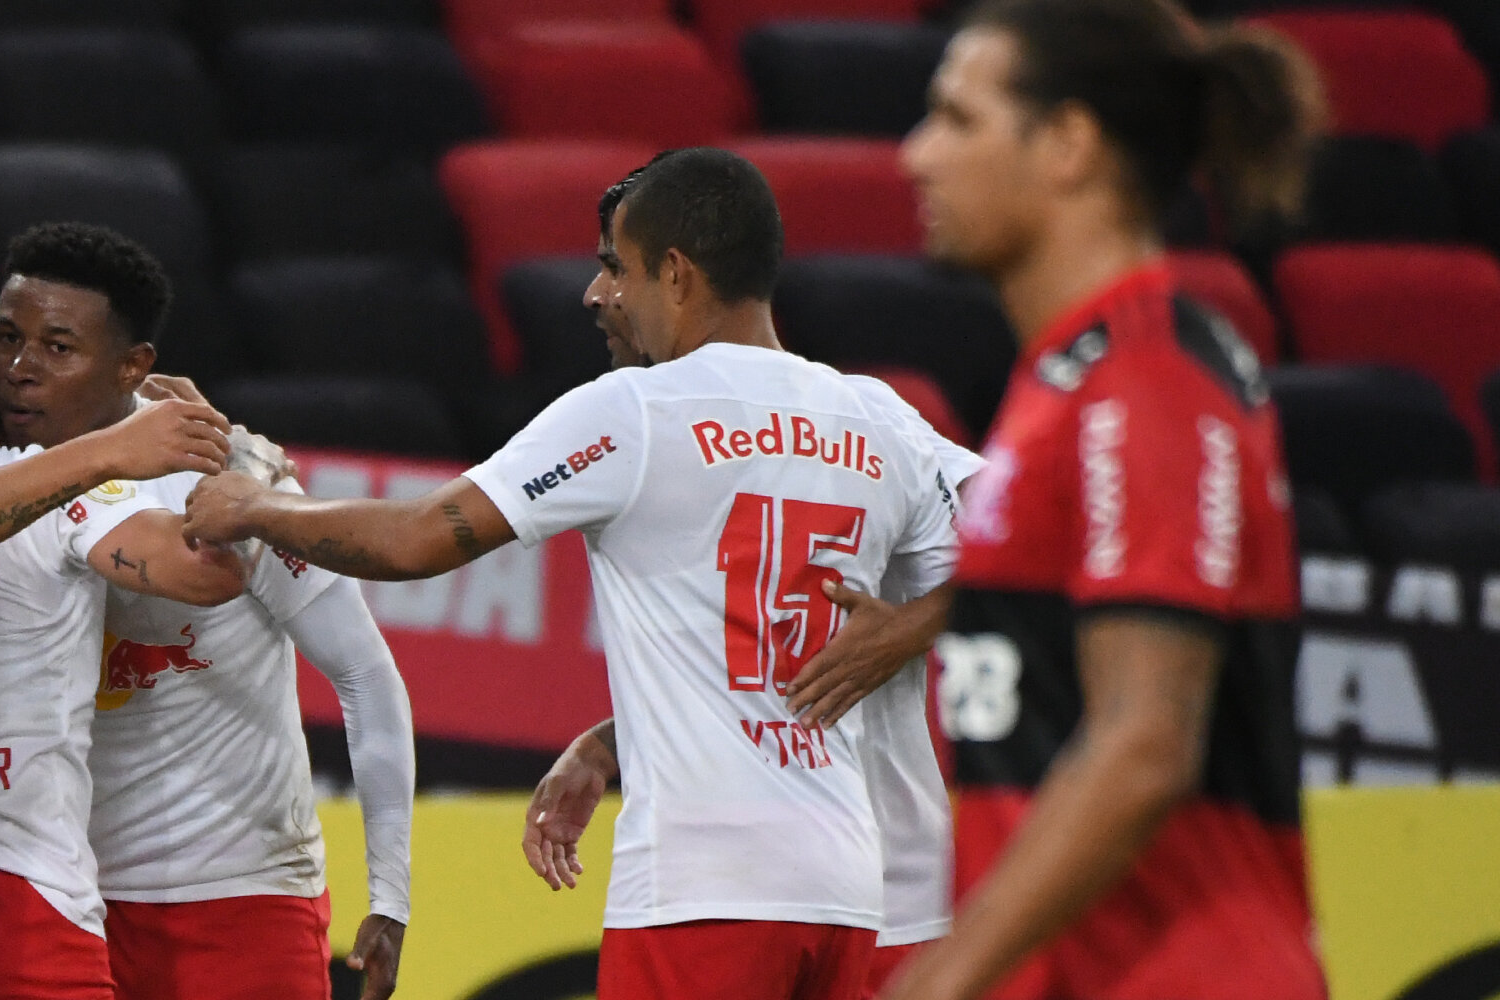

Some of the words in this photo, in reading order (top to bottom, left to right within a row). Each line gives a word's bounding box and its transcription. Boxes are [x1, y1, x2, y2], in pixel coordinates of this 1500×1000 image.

[522, 435, 617, 501] NetBet
[692, 413, 784, 465] Red
[791, 416, 883, 480] Bulls
[717, 492, 866, 696] 15
